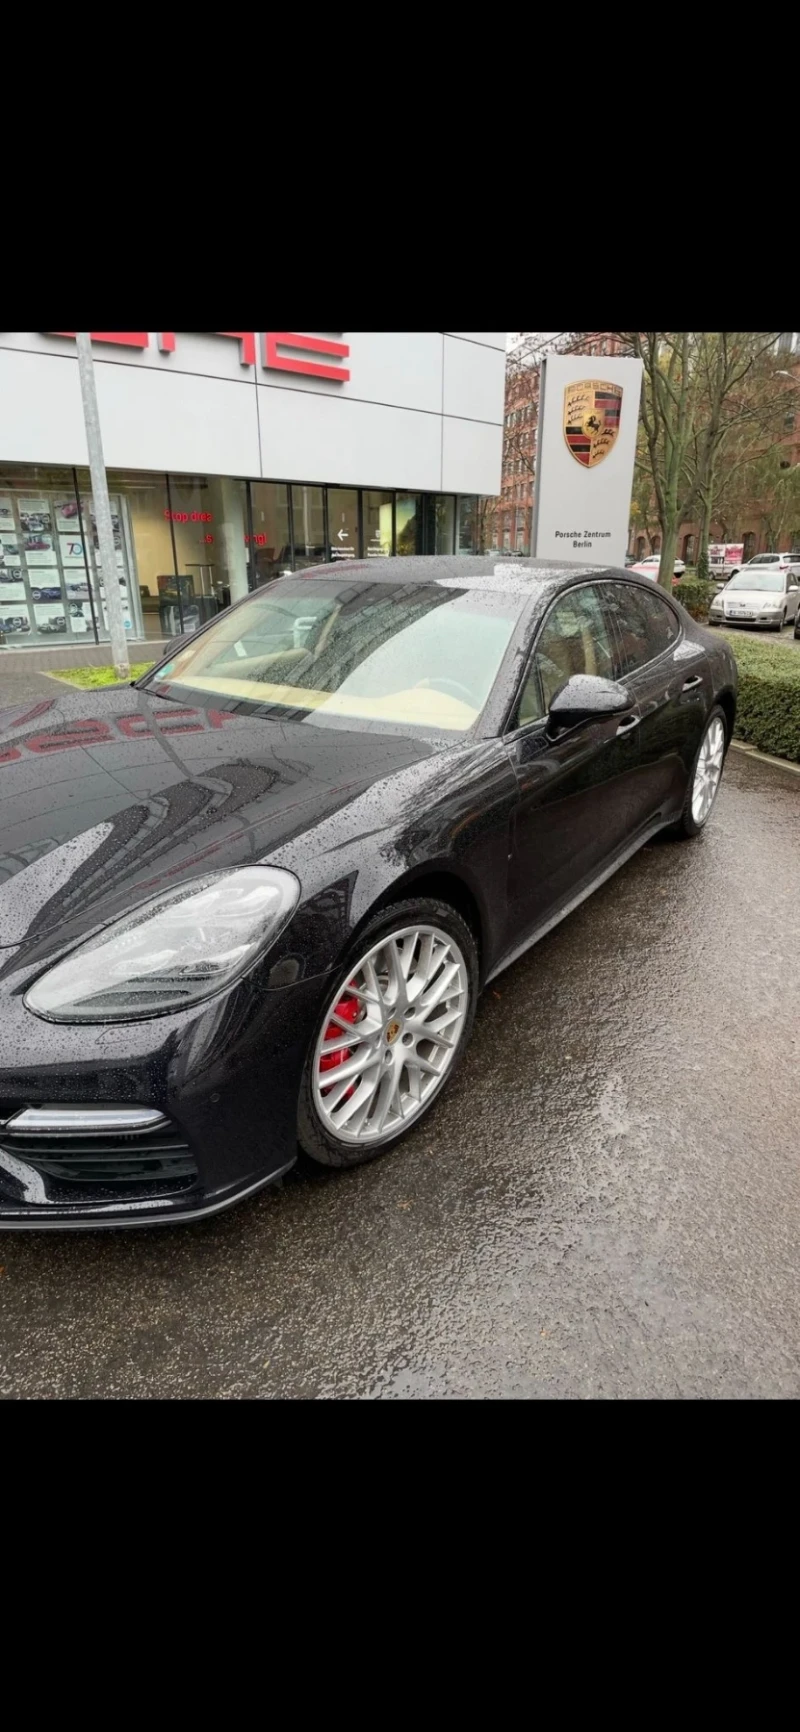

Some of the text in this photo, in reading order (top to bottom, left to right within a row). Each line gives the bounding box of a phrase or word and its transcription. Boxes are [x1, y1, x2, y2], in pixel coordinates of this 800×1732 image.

[555, 530, 611, 538] Porsche Zentrum
[573, 540, 592, 548] Berlin
